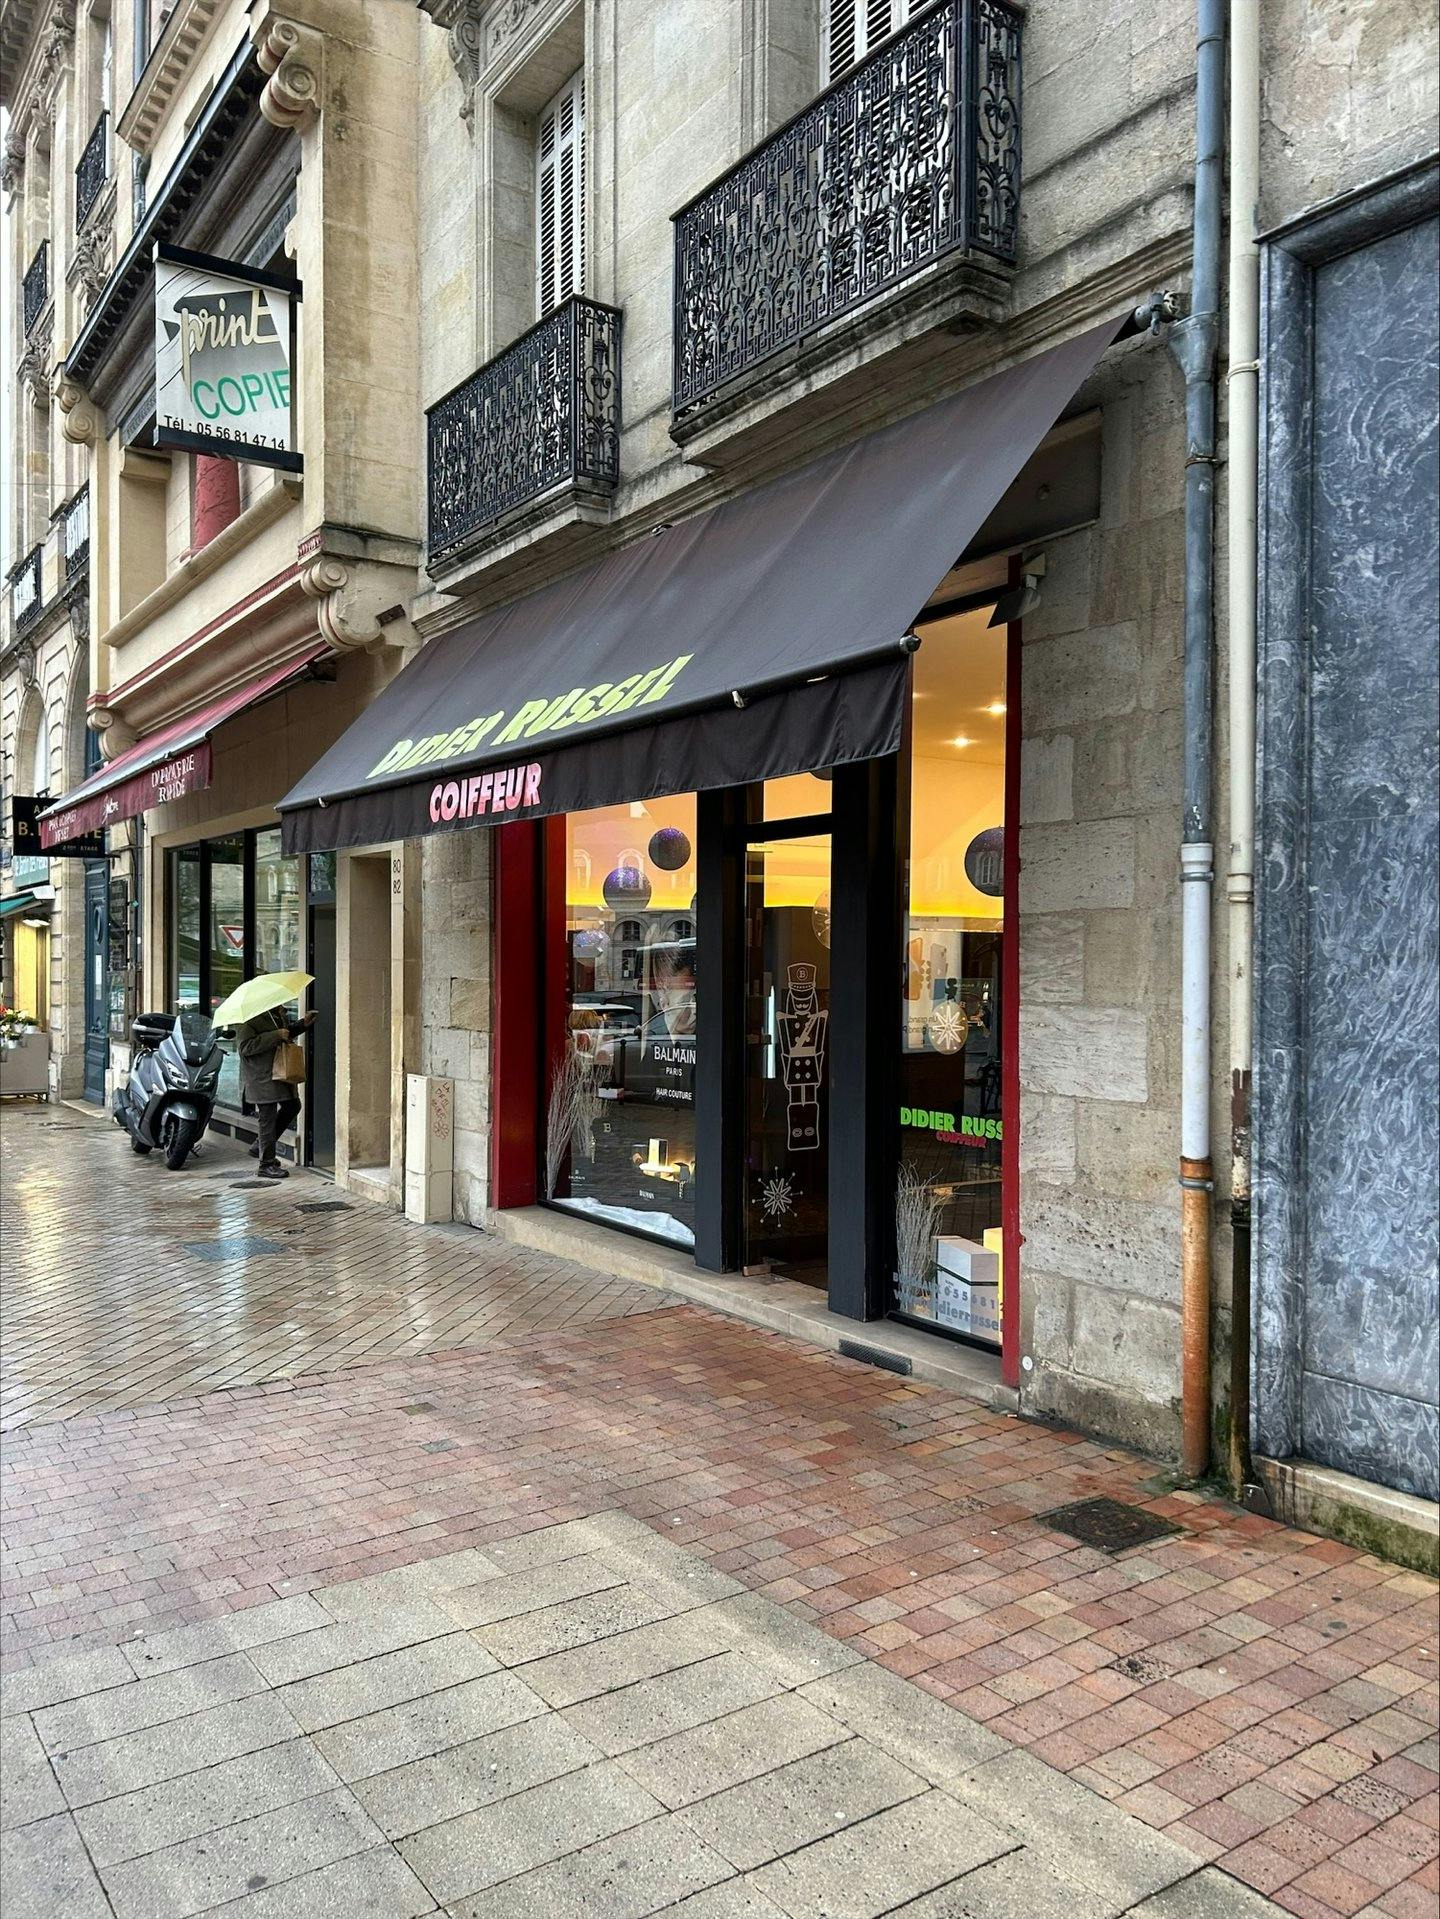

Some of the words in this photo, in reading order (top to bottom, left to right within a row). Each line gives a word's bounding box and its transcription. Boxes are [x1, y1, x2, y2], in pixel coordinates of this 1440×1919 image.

[197, 422, 212, 436] 05
[216, 426, 231, 440] 56
[234, 430, 247, 443] 81
[253, 434, 267, 447] 47
[271, 437, 285, 450] 14
[366, 710, 506, 780] DIDIER
[490, 653, 695, 746] RUSSEL
[429, 762, 543, 823] COIFFEUR
[393, 859, 401, 873] 80
[393, 879, 401, 894] 82
[654, 1046, 696, 1065] BALMAIN
[665, 1066, 683, 1077] PARIS
[668, 1089, 693, 1101] COUTURE
[900, 1106, 955, 1132] DIDIER
[936, 1131, 987, 1148] COIFFEUR
